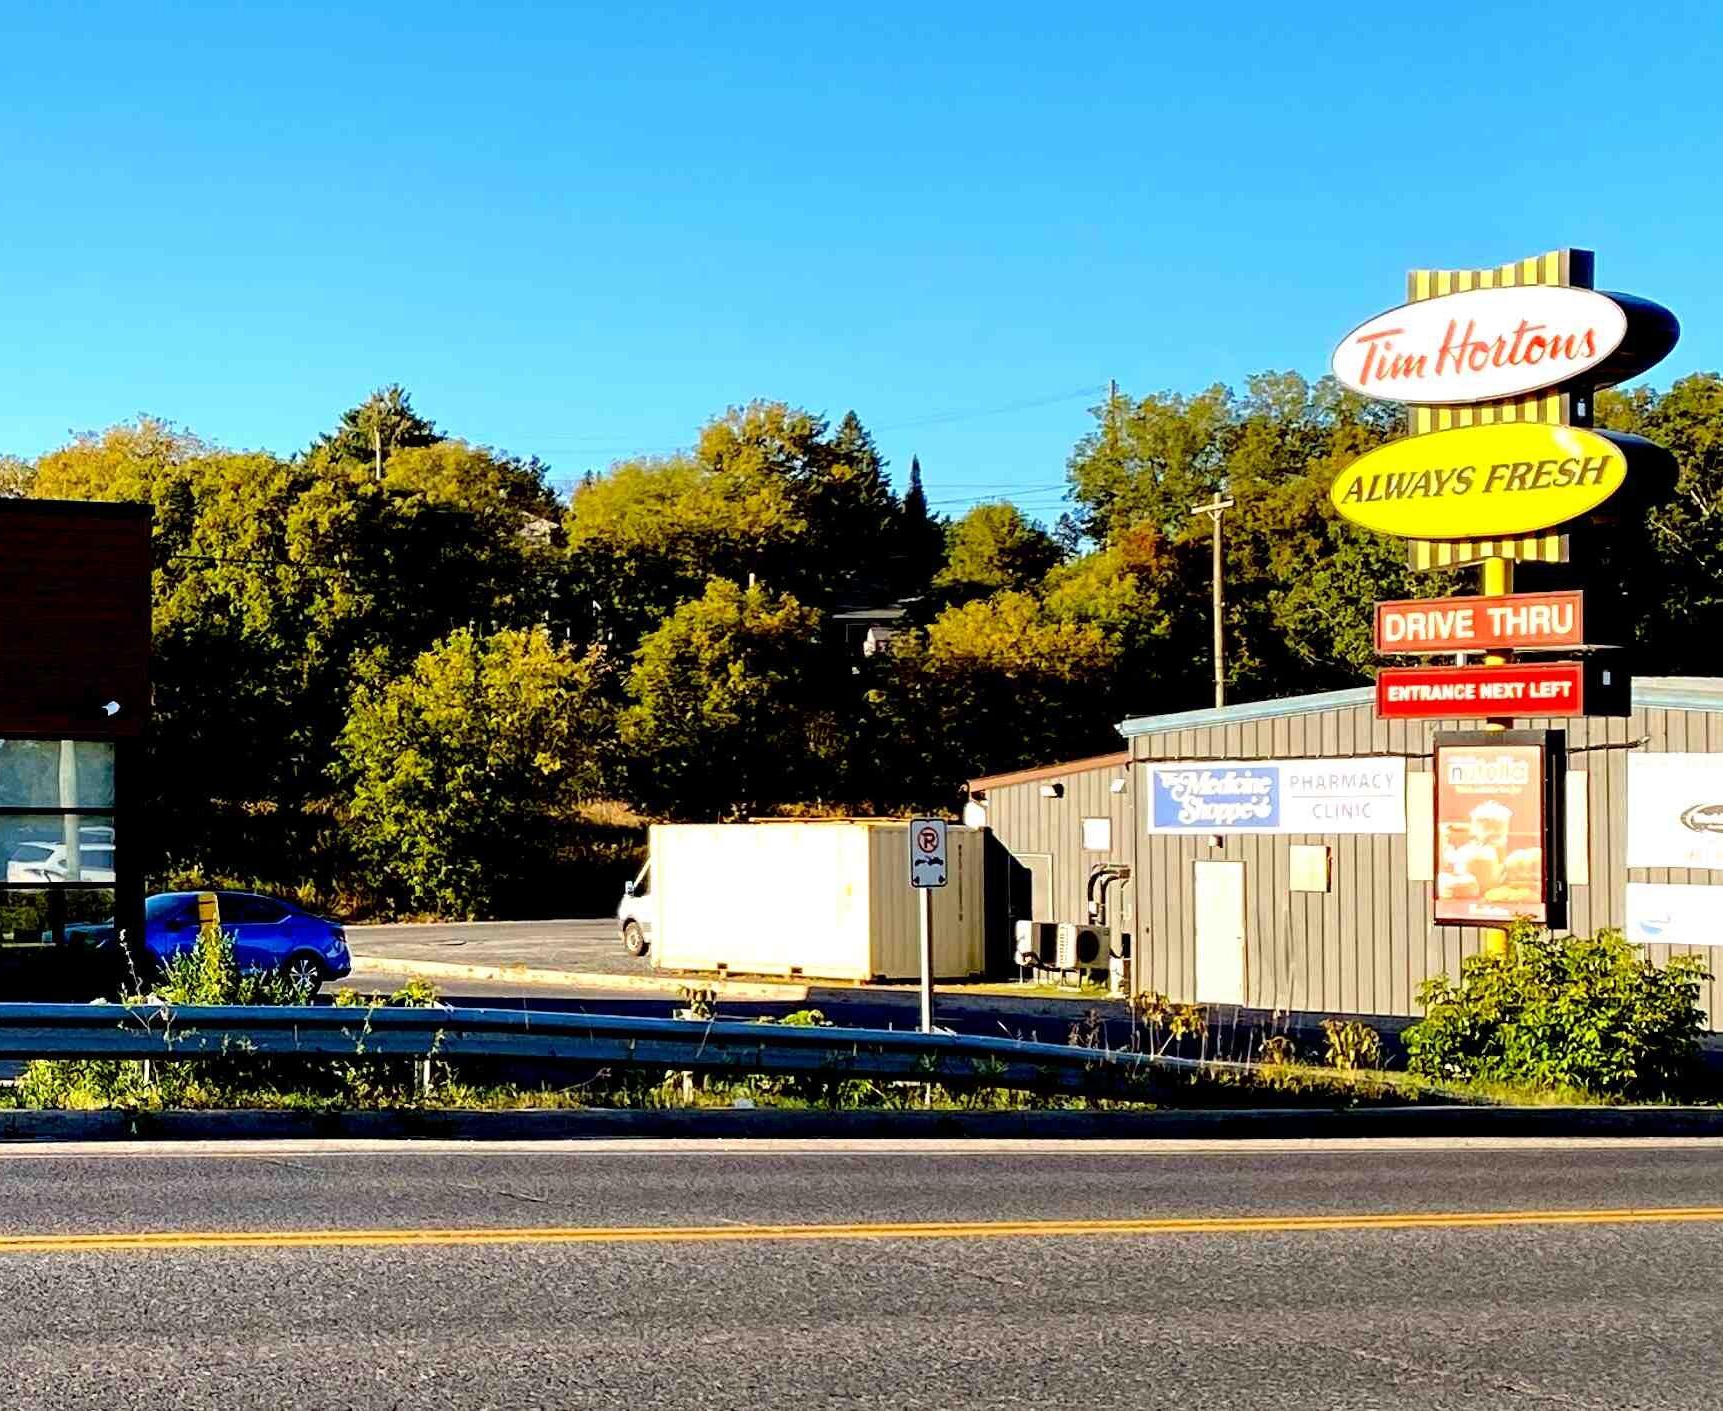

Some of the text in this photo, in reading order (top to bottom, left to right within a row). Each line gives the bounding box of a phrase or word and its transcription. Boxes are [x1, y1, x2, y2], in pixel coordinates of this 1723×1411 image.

[1356, 318, 1596, 386] Tim Hortons
[1340, 454, 1614, 504] ALWAYS FRESH
[1384, 603, 1574, 642] DRIVE THRU
[1387, 680, 1573, 702] ENTRANCE NEXT LEFT
[1289, 772, 1395, 791] PHARMACY
[1312, 802, 1372, 820] CLINIC
